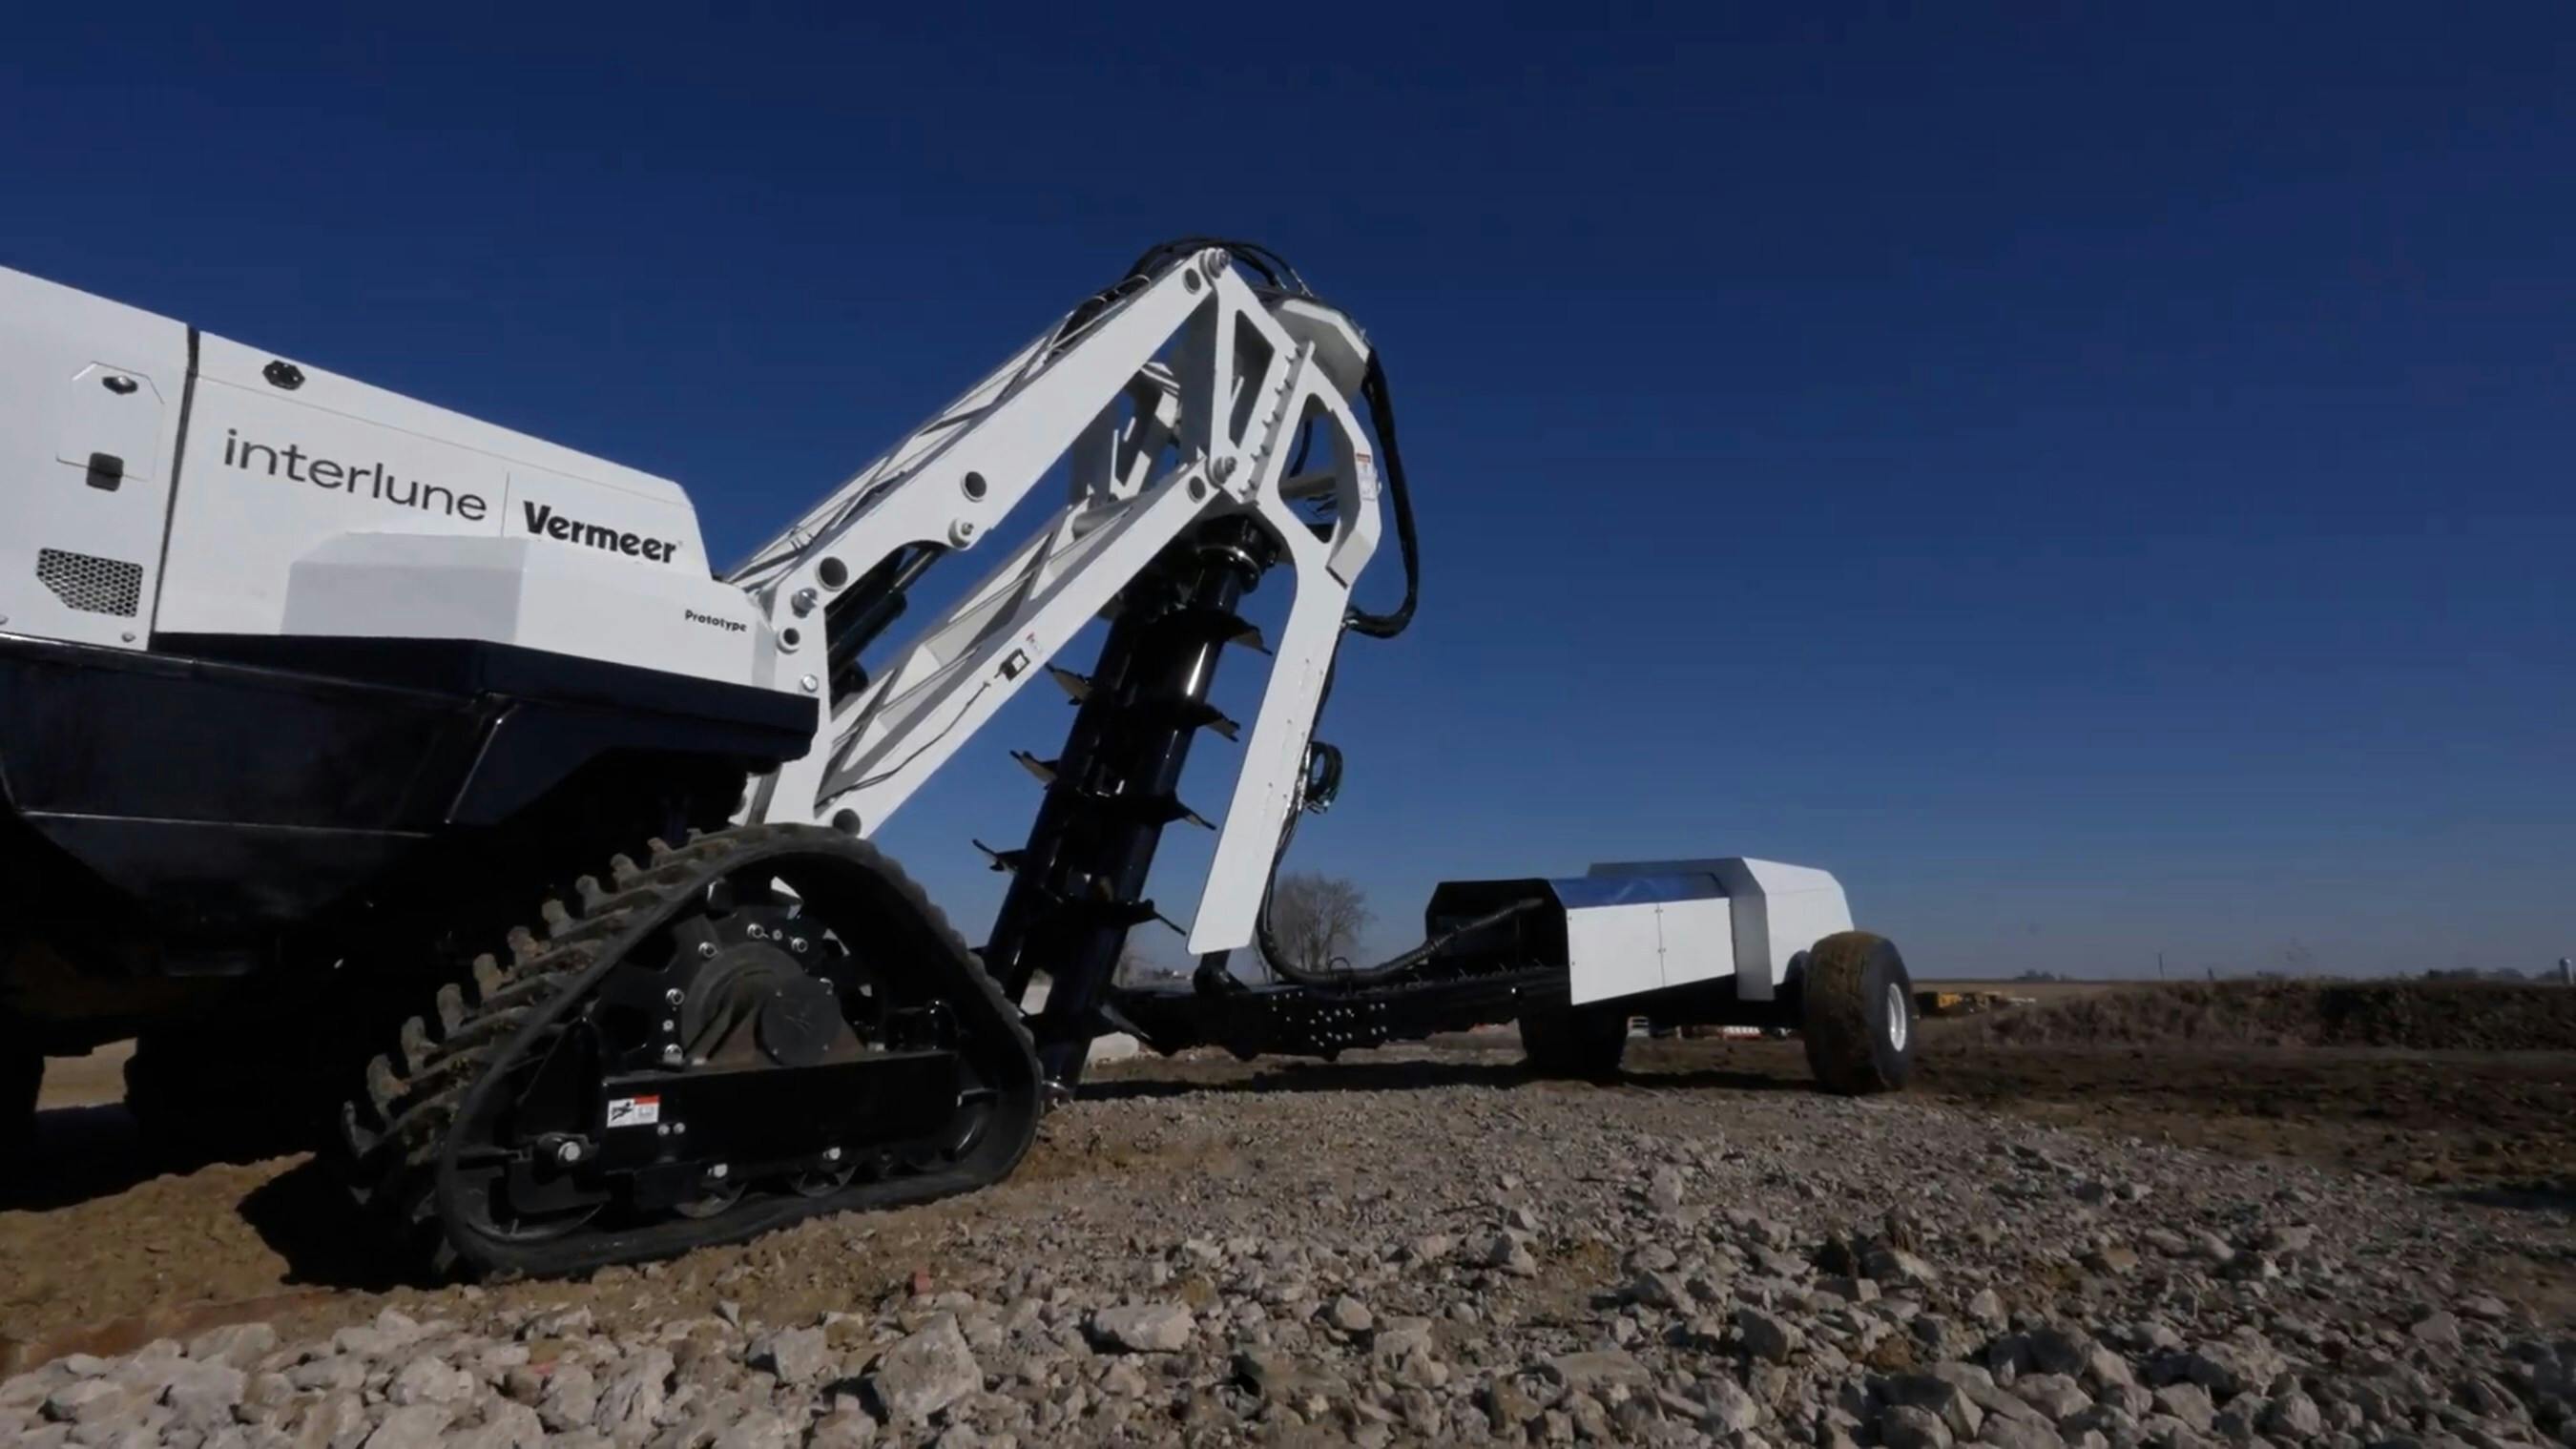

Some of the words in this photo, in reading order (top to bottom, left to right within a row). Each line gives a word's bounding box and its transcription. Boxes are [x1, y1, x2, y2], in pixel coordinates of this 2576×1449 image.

[224, 428, 487, 521] interlune
[523, 501, 677, 564] Vermeer
[684, 609, 747, 631] Prototype
